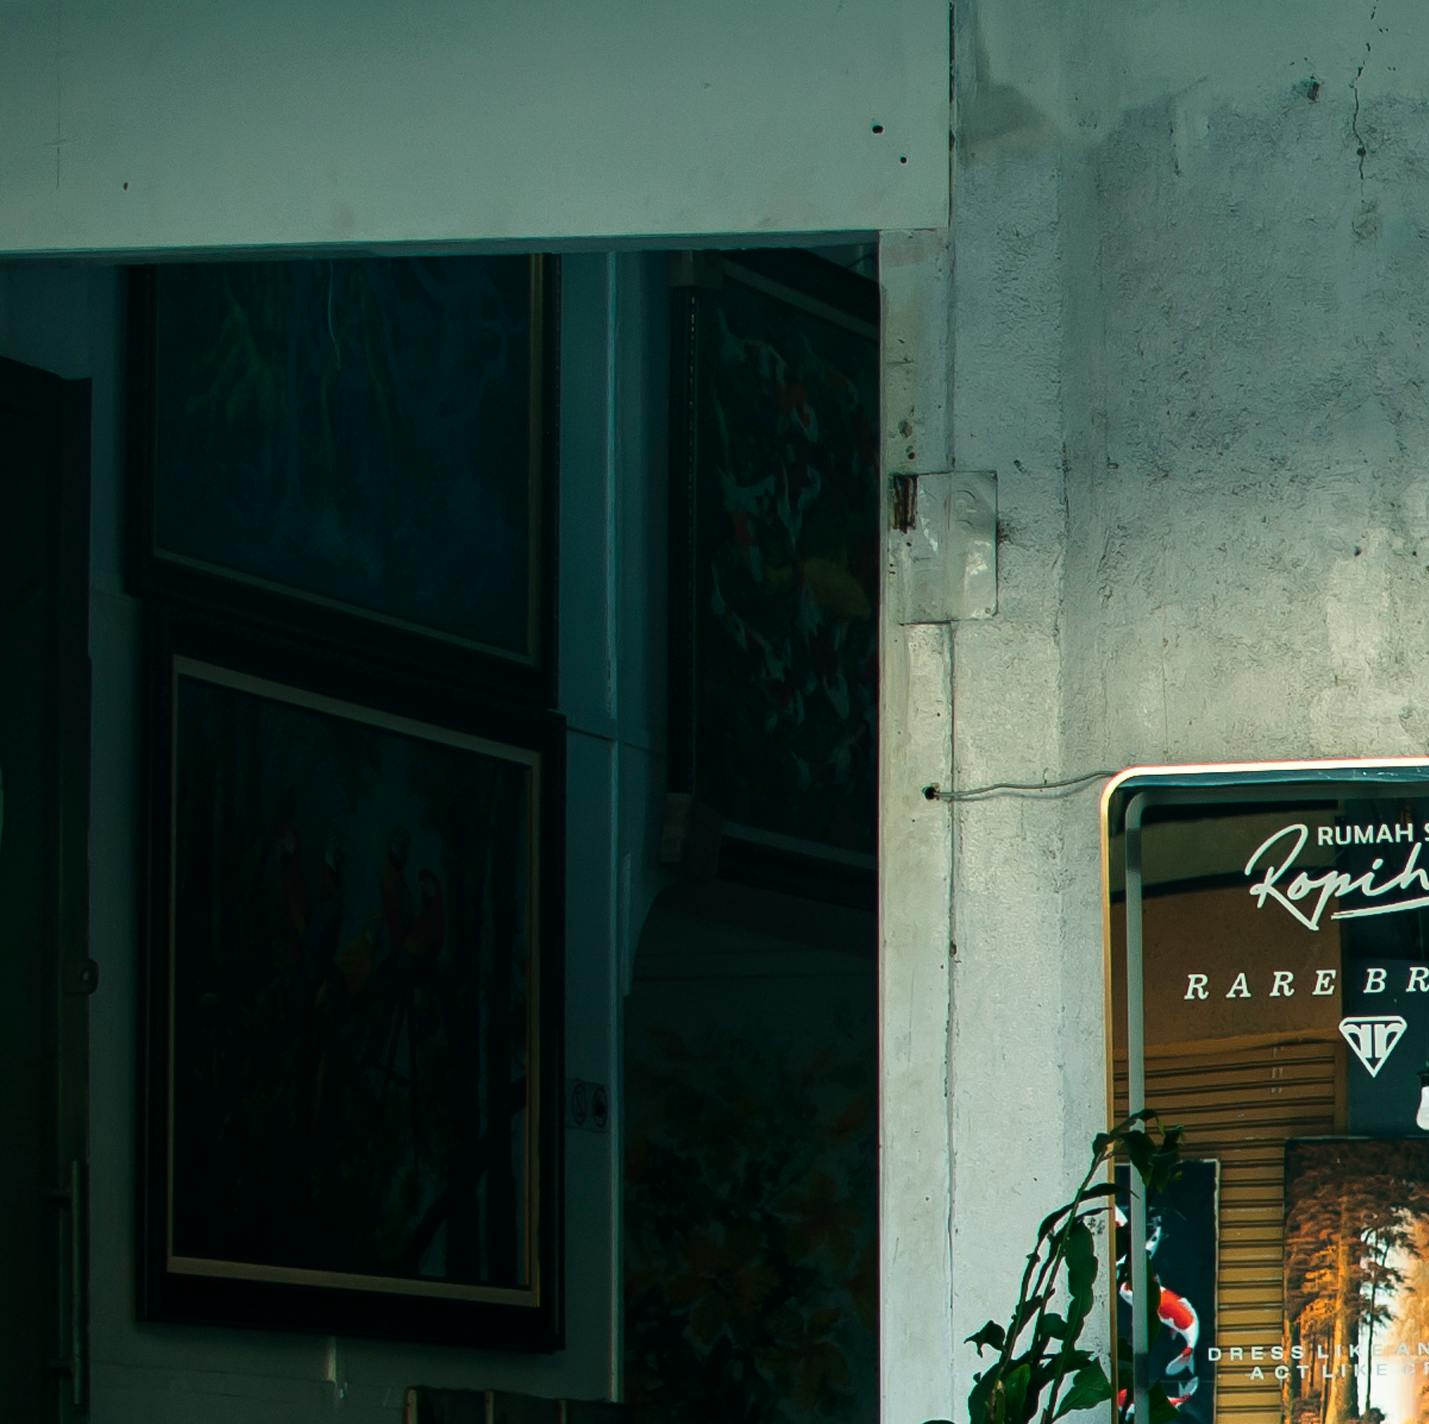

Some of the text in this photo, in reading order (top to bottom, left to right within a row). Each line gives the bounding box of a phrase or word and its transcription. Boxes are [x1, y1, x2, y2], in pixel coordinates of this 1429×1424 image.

[1317, 823, 1413, 846] RUMAH
[1184, 969, 1337, 1000] RARE
[1208, 1346, 1306, 1362] DRESS
[1317, 1343, 1384, 1359] LIKE
[1250, 1364, 1310, 1380] ACT
[1322, 1363, 1388, 1379] LIKE
